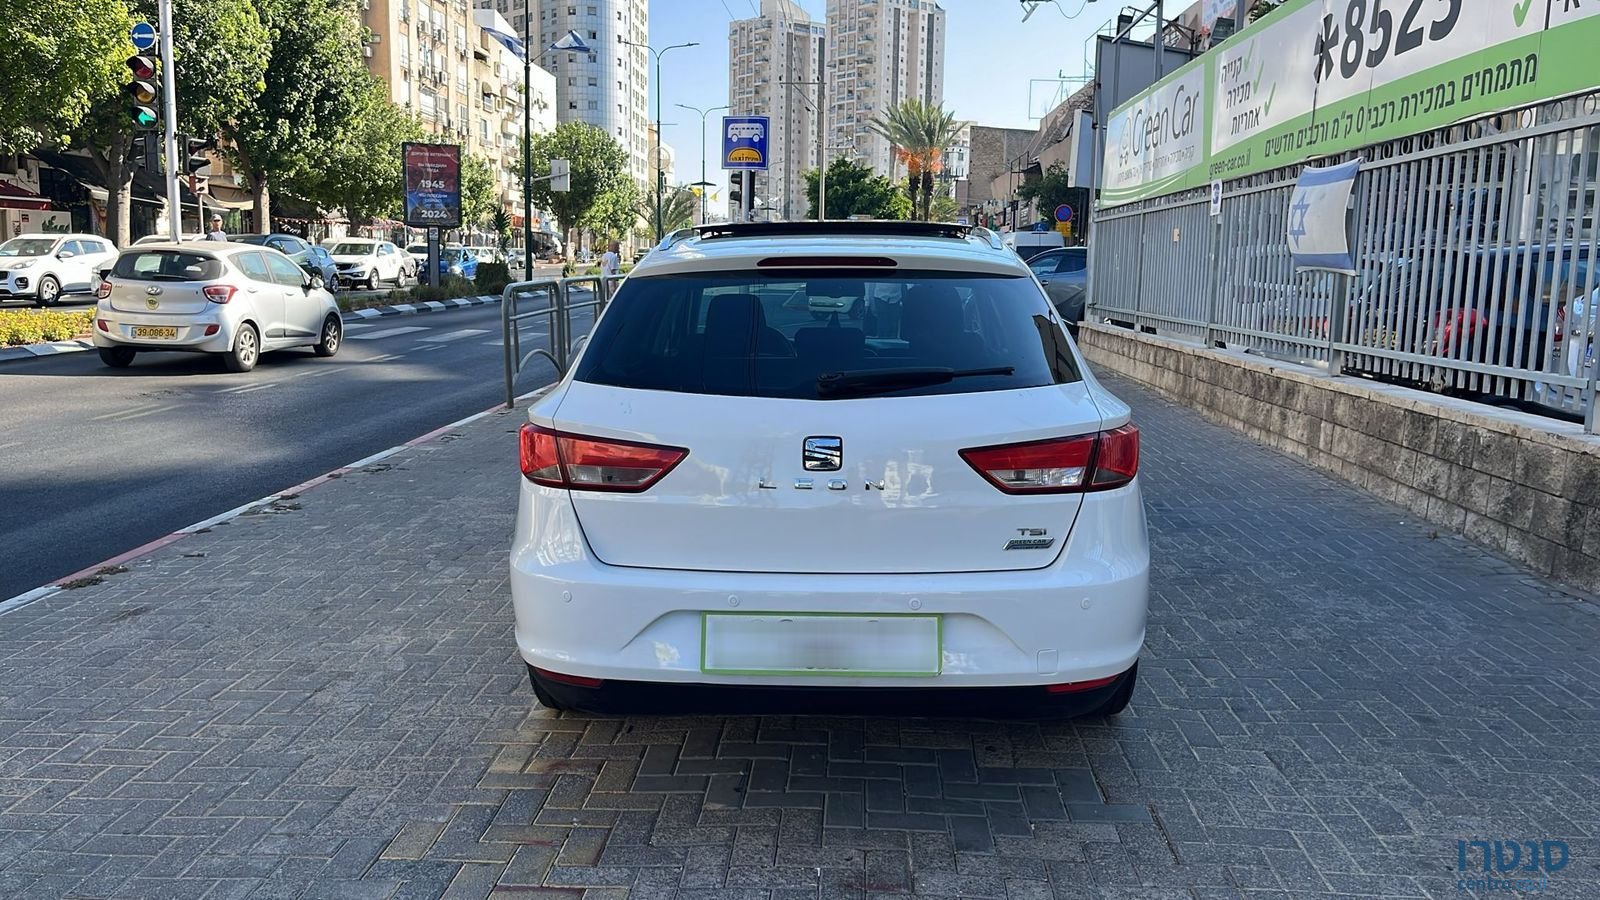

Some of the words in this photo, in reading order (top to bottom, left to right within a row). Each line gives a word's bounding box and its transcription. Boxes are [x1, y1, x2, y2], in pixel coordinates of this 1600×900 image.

[1221, 56, 1242, 84] קנייה
[1461, 53, 1537, 102] מתמחים
[1226, 81, 1251, 109] מכירה
[1398, 80, 1456, 121] במכירת
[1132, 107, 1169, 156] Green
[1172, 84, 1199, 140] Car
[1231, 106, 1261, 136] אחריות
[1368, 100, 1395, 129] רכבי
[1264, 132, 1295, 158] חדשים
[1296, 121, 1329, 149] ורכבים
[421, 180, 445, 189] 1945
[421, 209, 447, 219] 2024
[758, 477, 885, 490] LEON
